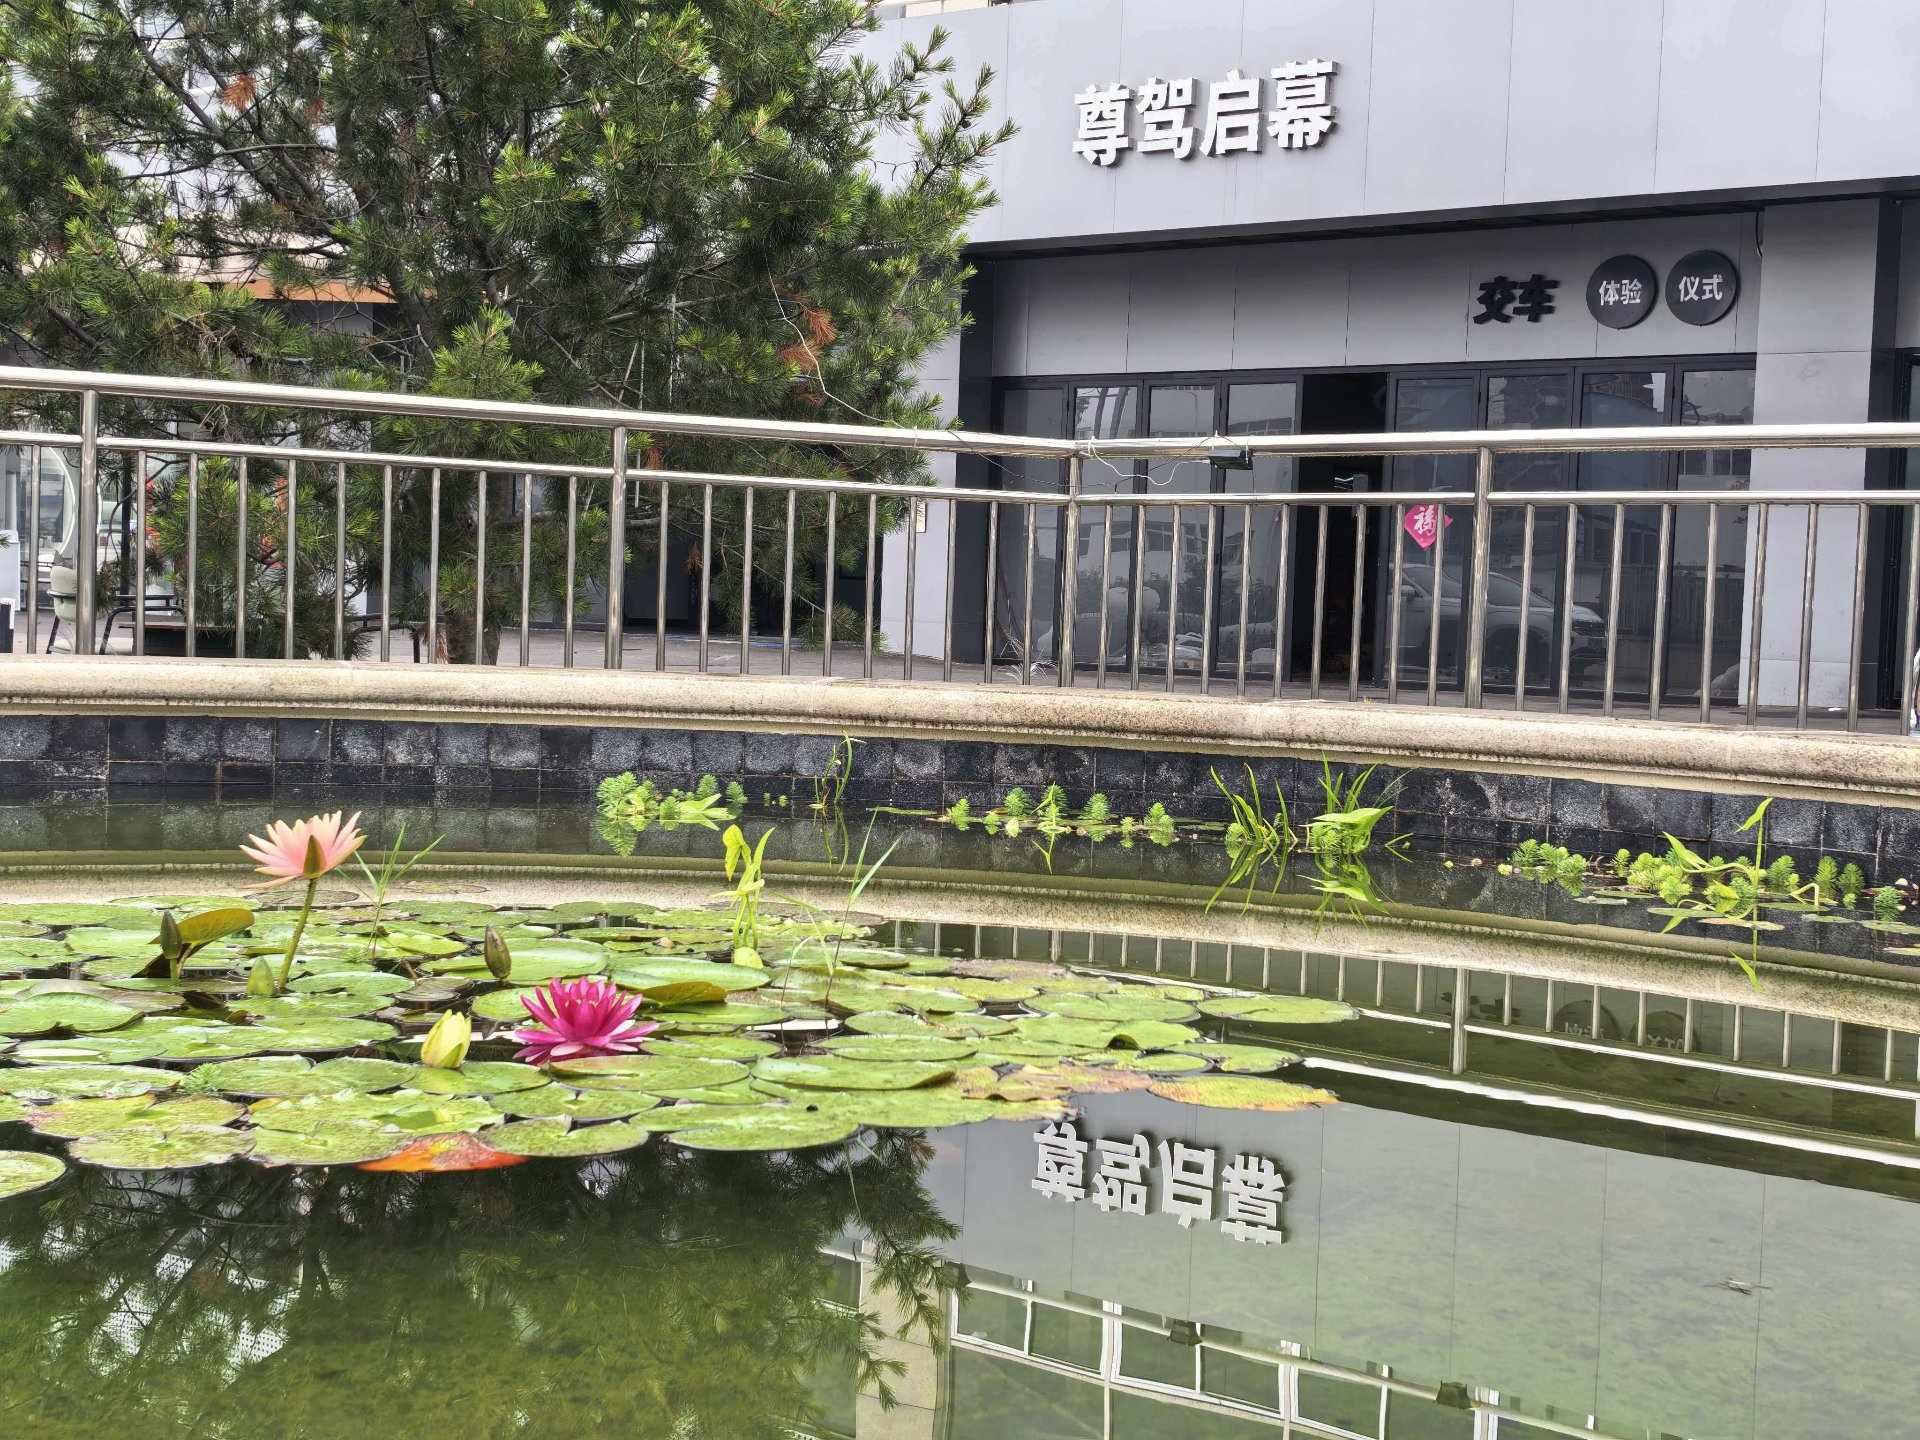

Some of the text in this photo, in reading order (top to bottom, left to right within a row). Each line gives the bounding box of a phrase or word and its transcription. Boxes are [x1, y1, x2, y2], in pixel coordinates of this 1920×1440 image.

[1072, 59, 1338, 167] 尊驾启幕
[1473, 273, 1723, 325] 交车 体验 仪式
